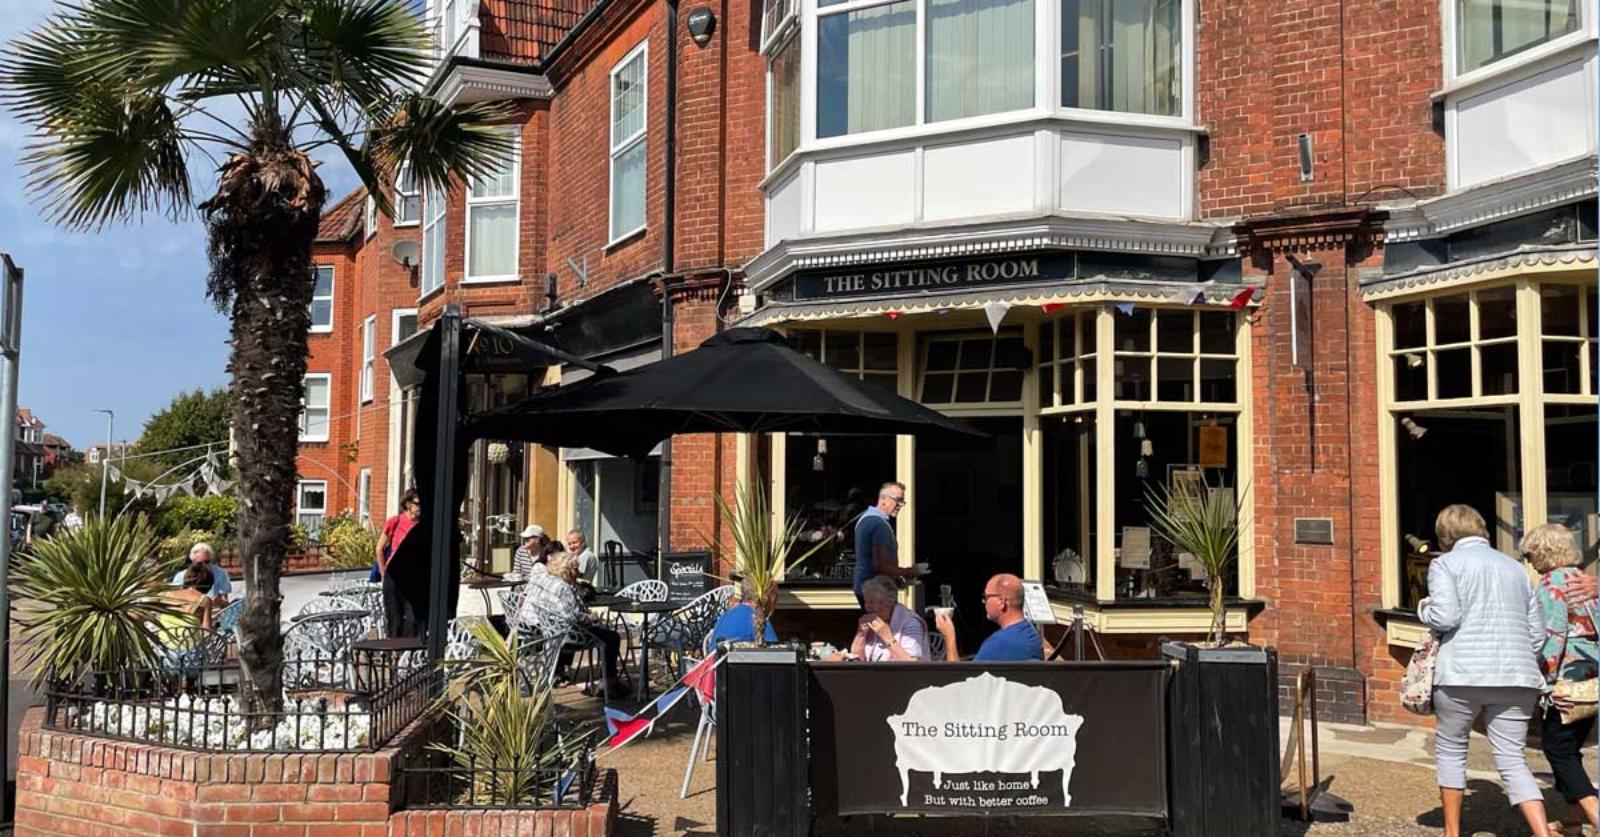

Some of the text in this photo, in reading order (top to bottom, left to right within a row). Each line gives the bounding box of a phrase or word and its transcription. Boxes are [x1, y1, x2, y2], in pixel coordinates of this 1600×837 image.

[824, 259, 1040, 293] THE SITTING ROOM
[902, 721, 1069, 741] The Sitting Room
[943, 779, 1030, 791] Just like home
[924, 794, 1049, 807] But with better coffee
